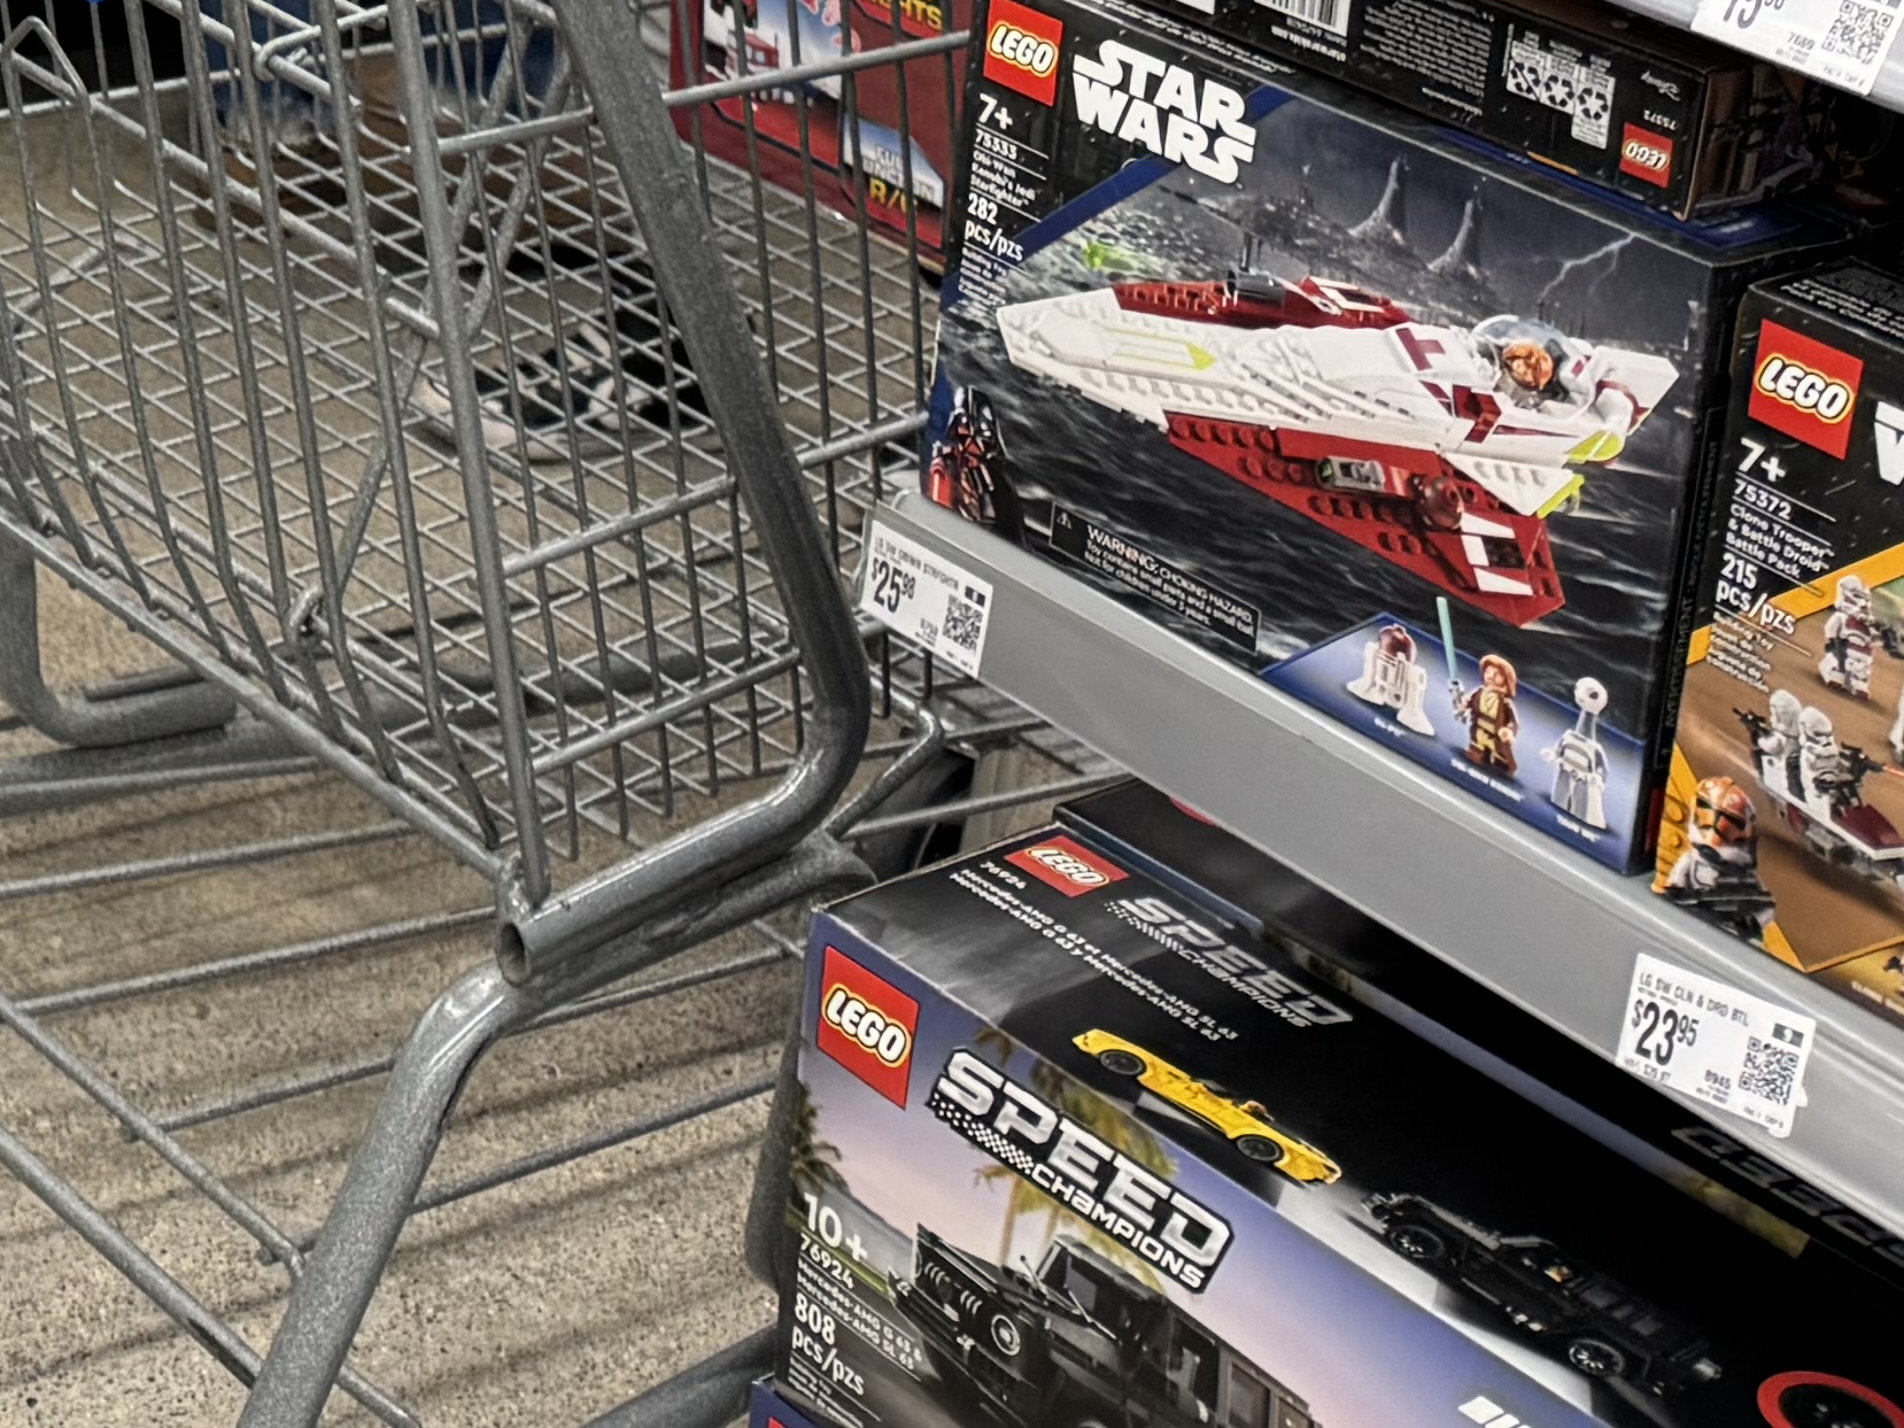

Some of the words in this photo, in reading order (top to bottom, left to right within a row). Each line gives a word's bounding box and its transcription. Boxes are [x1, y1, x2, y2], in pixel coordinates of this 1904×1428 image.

[978, 92, 1014, 130] 7+
[989, 22, 1057, 76] LEGO
[1072, 39, 1257, 146] STAR
[975, 128, 1018, 161] 75333
[1072, 71, 1255, 185] WARS
[1623, 136, 1669, 174] LEGO
[967, 192, 999, 227] 282
[964, 220, 1024, 263] pcs/pzs
[1757, 355, 1854, 421] LEGO
[1740, 436, 1787, 484] 7+
[1730, 503, 1770, 535] Clone
[1733, 479, 1792, 521] 75372
[1725, 530, 1767, 567] Battle
[1767, 551, 1801, 579] Pack
[1740, 522, 1782, 553] Battle
[871, 556, 917, 615] $2598
[1719, 552, 1759, 591] 215
[1715, 579, 1797, 636] pcs/pzs
[980, 860, 1028, 890] 76924
[1026, 847, 1110, 886] LEGO
[1084, 954, 1183, 1019] Mercedes-AMG
[1101, 953, 1200, 1017] Mercedes-AMG
[1120, 896, 1355, 1027] SPEED
[823, 983, 911, 1067] LEGO
[1631, 997, 1700, 1068] $2395
[937, 1048, 1234, 1268] SPEED
[803, 1191, 868, 1263] 10+
[800, 1232, 855, 1290] 76924
[794, 1292, 837, 1346] 808
[796, 1272, 881, 1346] Mercedes-AMG
[797, 1257, 882, 1331] Mercedes-AMG
[792, 1325, 866, 1397] pcs/pzs
